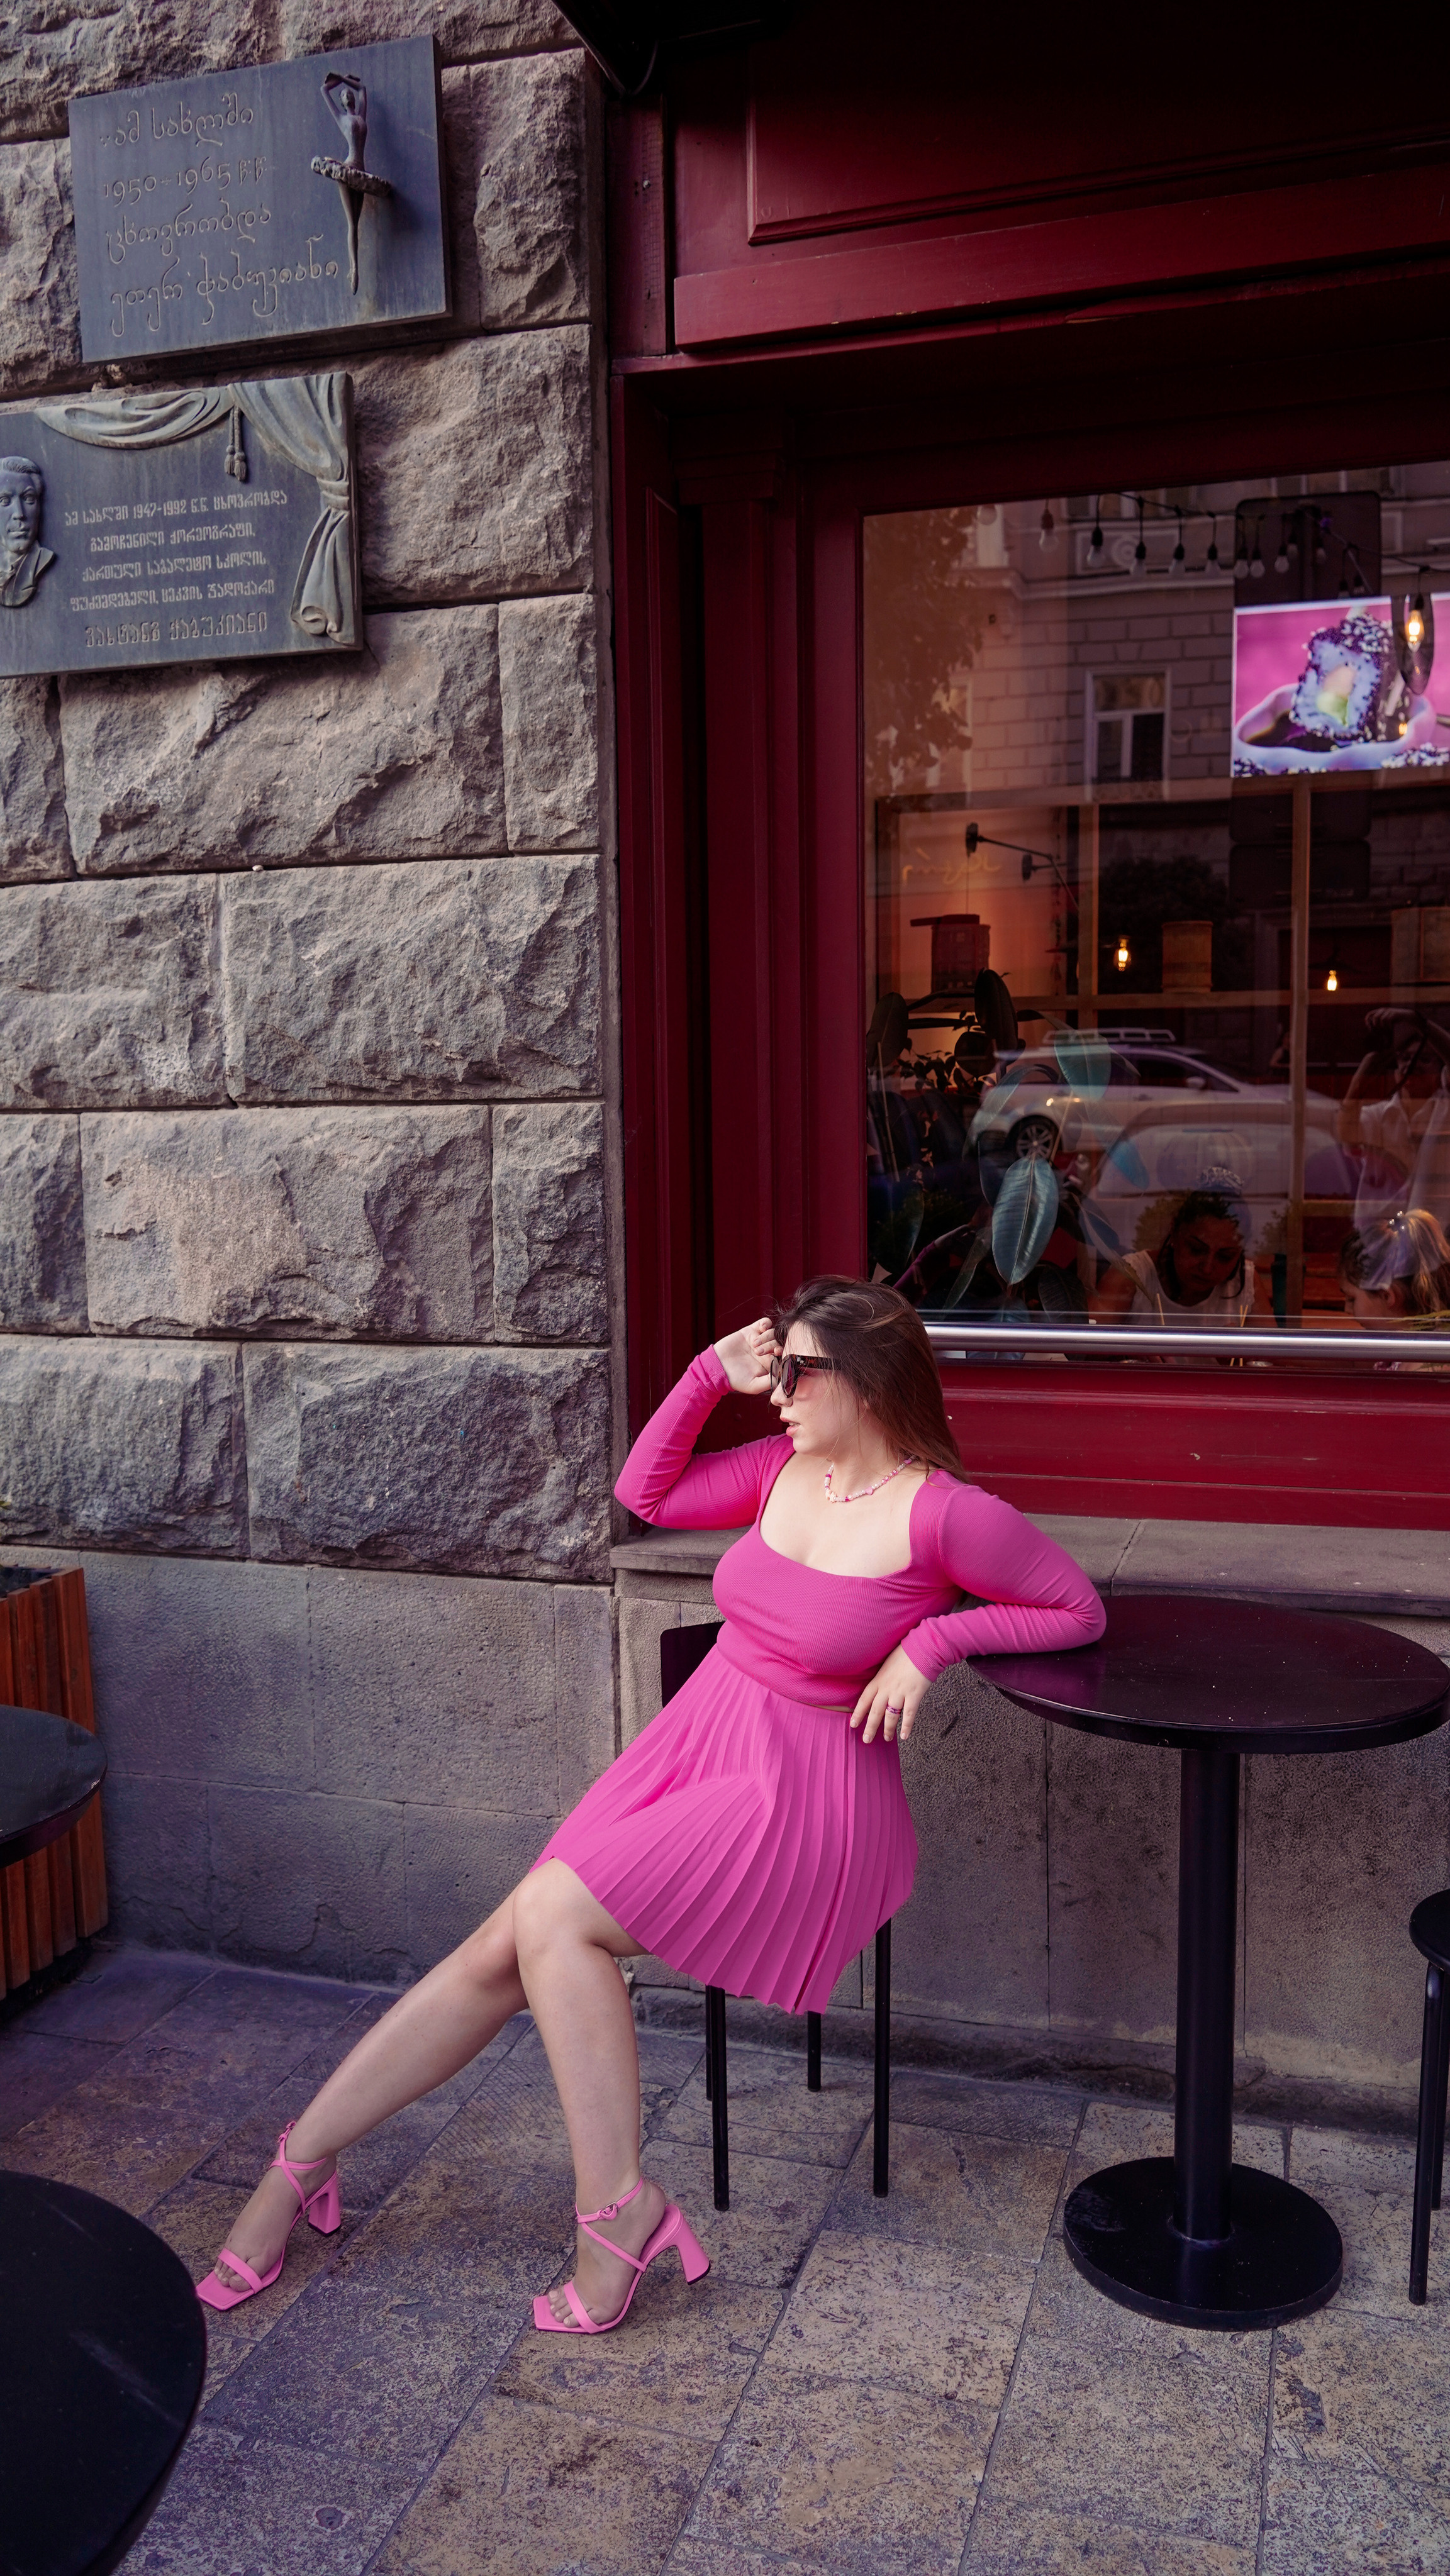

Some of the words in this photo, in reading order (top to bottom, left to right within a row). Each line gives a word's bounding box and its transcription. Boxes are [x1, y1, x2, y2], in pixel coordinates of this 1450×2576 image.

[115, 109, 140, 145] ამ
[152, 92, 253, 147] სახლში
[106, 197, 270, 264] ცხოვრობდა
[111, 257, 182, 337] ეთერ
[65, 511, 79, 526] ამ
[83, 505, 128, 524] სახლში
[133, 499, 186, 519] 1947-1992
[214, 490, 287, 511] ცხოვრობდა
[91, 531, 165, 552] გამოჩენილი
[82, 562, 141, 582] ქართული
[147, 555, 211, 575] საბალეტო
[216, 551, 266, 569] სკოლის
[162, 586, 203, 602] ცეკვის
[208, 579, 274, 599] ჯადოქარი
[85, 621, 160, 647] ვახტანგ
[170, 611, 267, 640] ჭაბუკიანი
